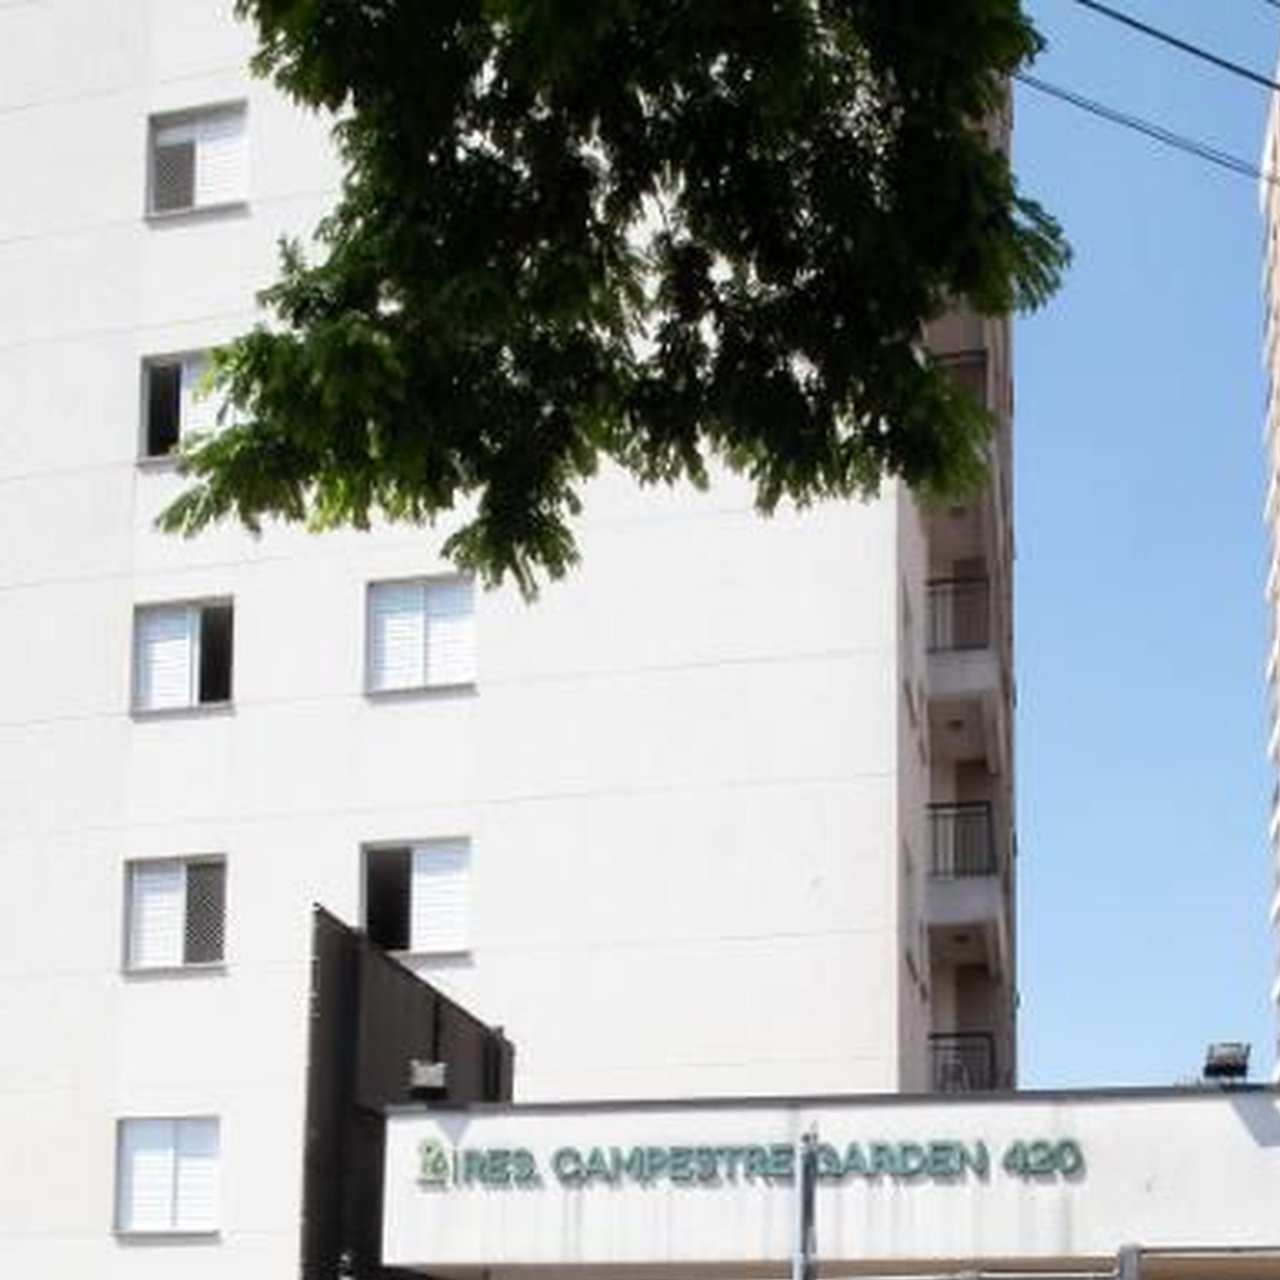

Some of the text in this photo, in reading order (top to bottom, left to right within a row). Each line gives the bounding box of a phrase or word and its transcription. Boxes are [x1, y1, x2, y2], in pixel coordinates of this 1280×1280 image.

[553, 1145, 796, 1181] CAMPESTRE
[814, 1142, 990, 1177] GARDEN
[1002, 1139, 1086, 1176] 420
